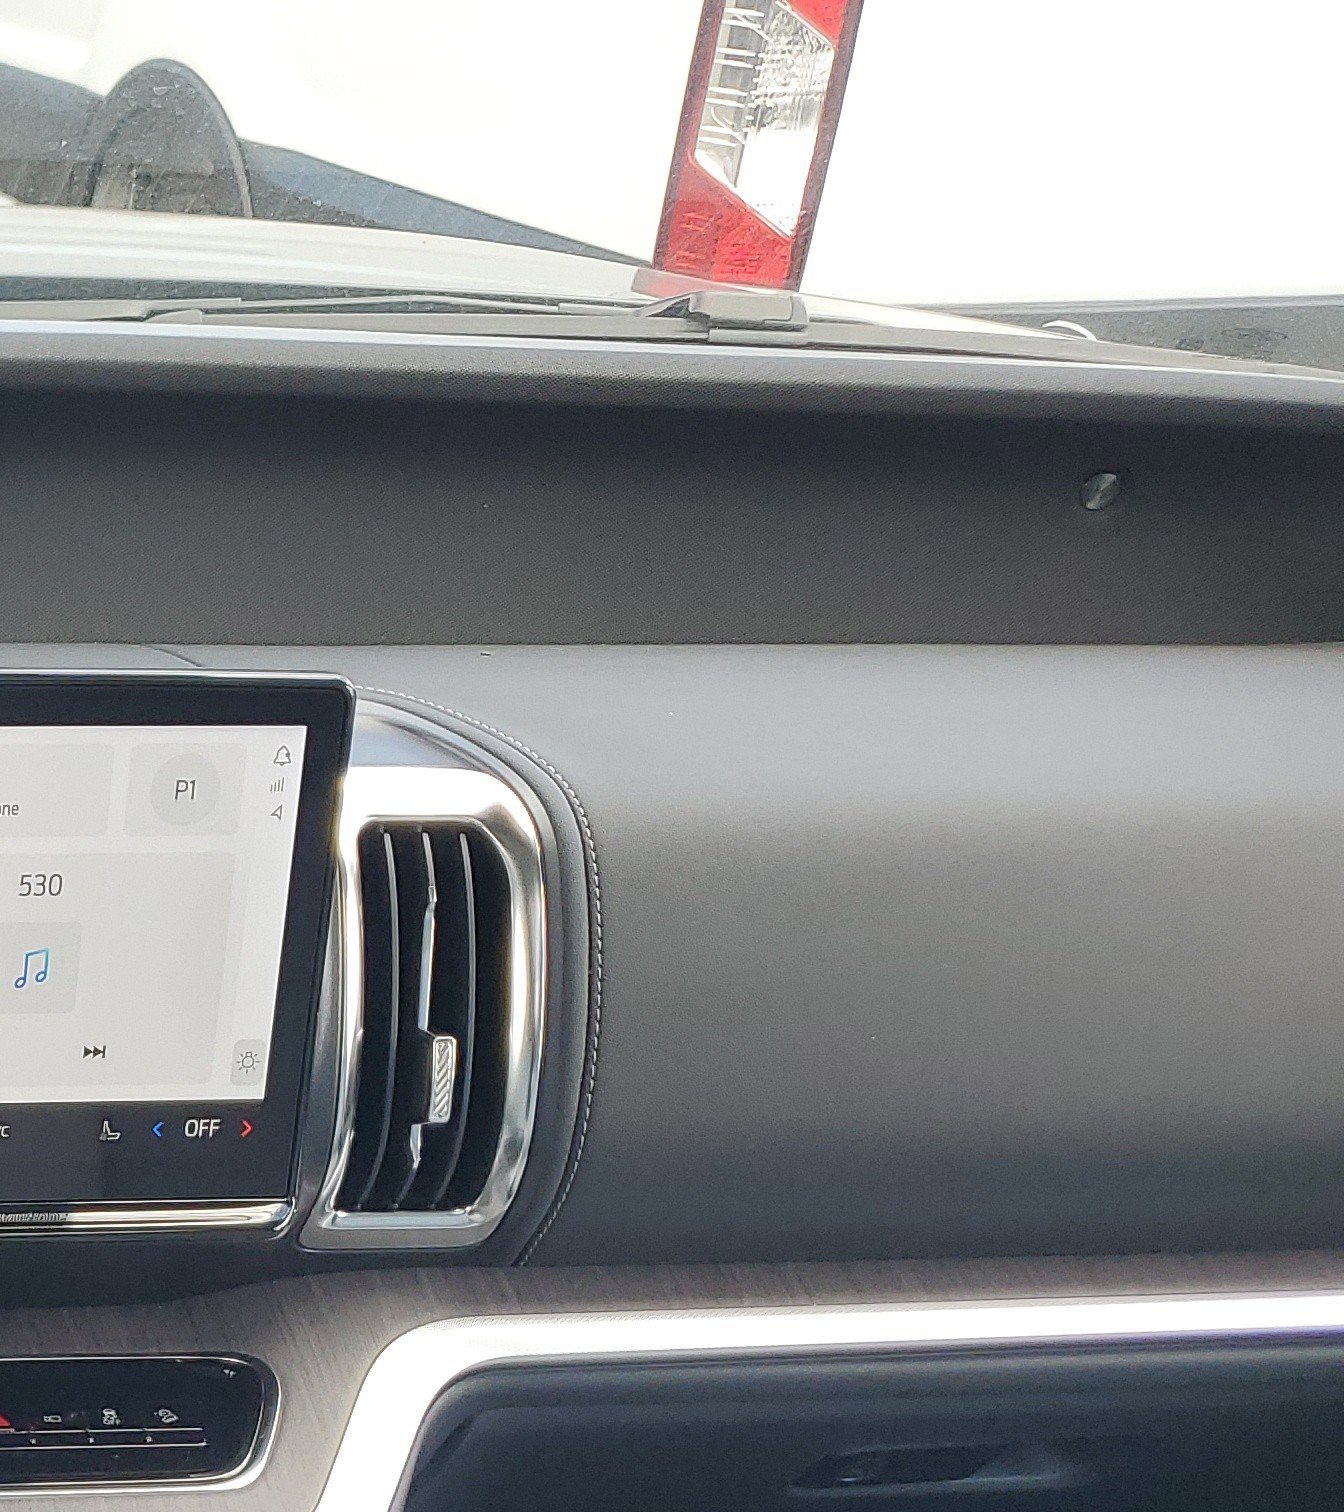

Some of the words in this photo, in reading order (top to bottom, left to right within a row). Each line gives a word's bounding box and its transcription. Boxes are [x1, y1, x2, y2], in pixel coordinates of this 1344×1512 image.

[174, 779, 197, 800] P1
[18, 873, 63, 897] 530
[183, 1119, 221, 1137] OFF
